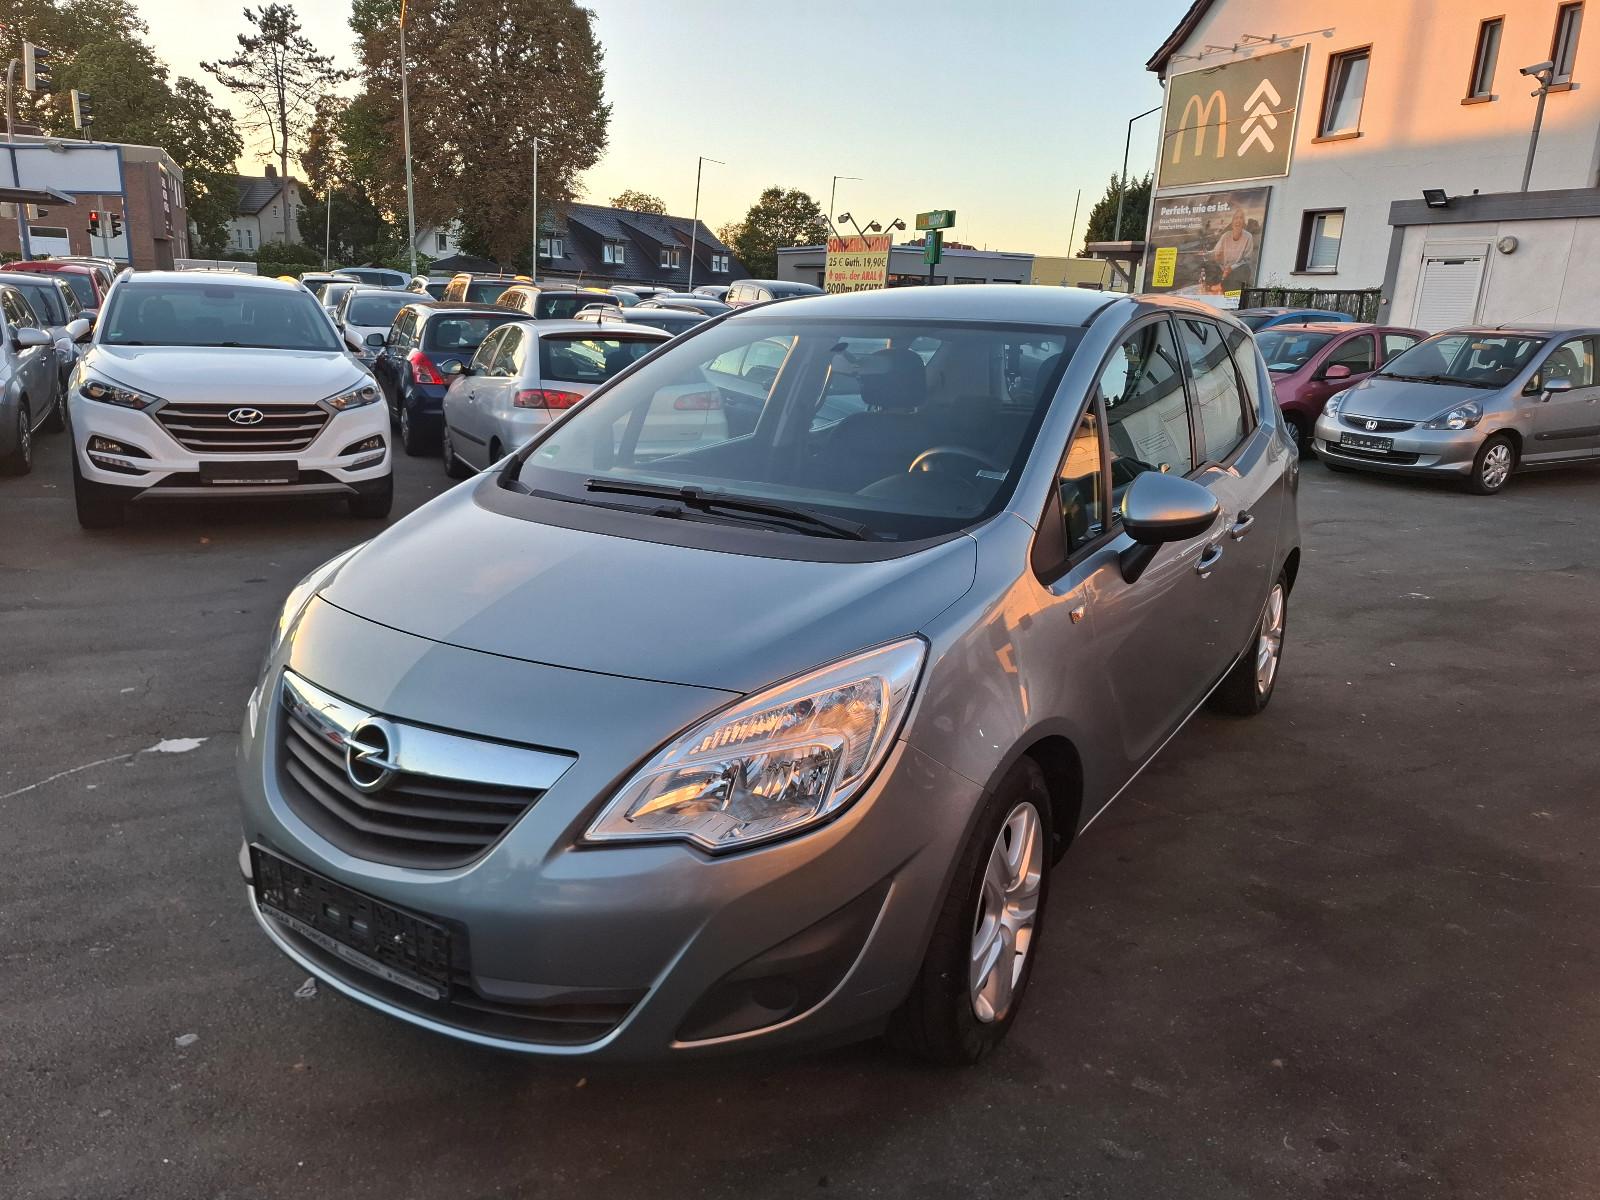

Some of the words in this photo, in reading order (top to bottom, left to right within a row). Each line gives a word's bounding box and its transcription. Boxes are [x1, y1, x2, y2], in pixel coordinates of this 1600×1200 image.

[1161, 205, 1191, 216] Perfekt,
[1193, 203, 1206, 213] wie
[1207, 204, 1217, 212] es
[1217, 201, 1230, 212] ist.
[829, 257, 837, 267] 25
[838, 257, 843, 267] €
[844, 256, 862, 267] Guth.
[863, 257, 886, 269] 19,90€
[850, 270, 860, 280] der
[862, 270, 877, 280] ARAL
[827, 283, 852, 294] 3000m
